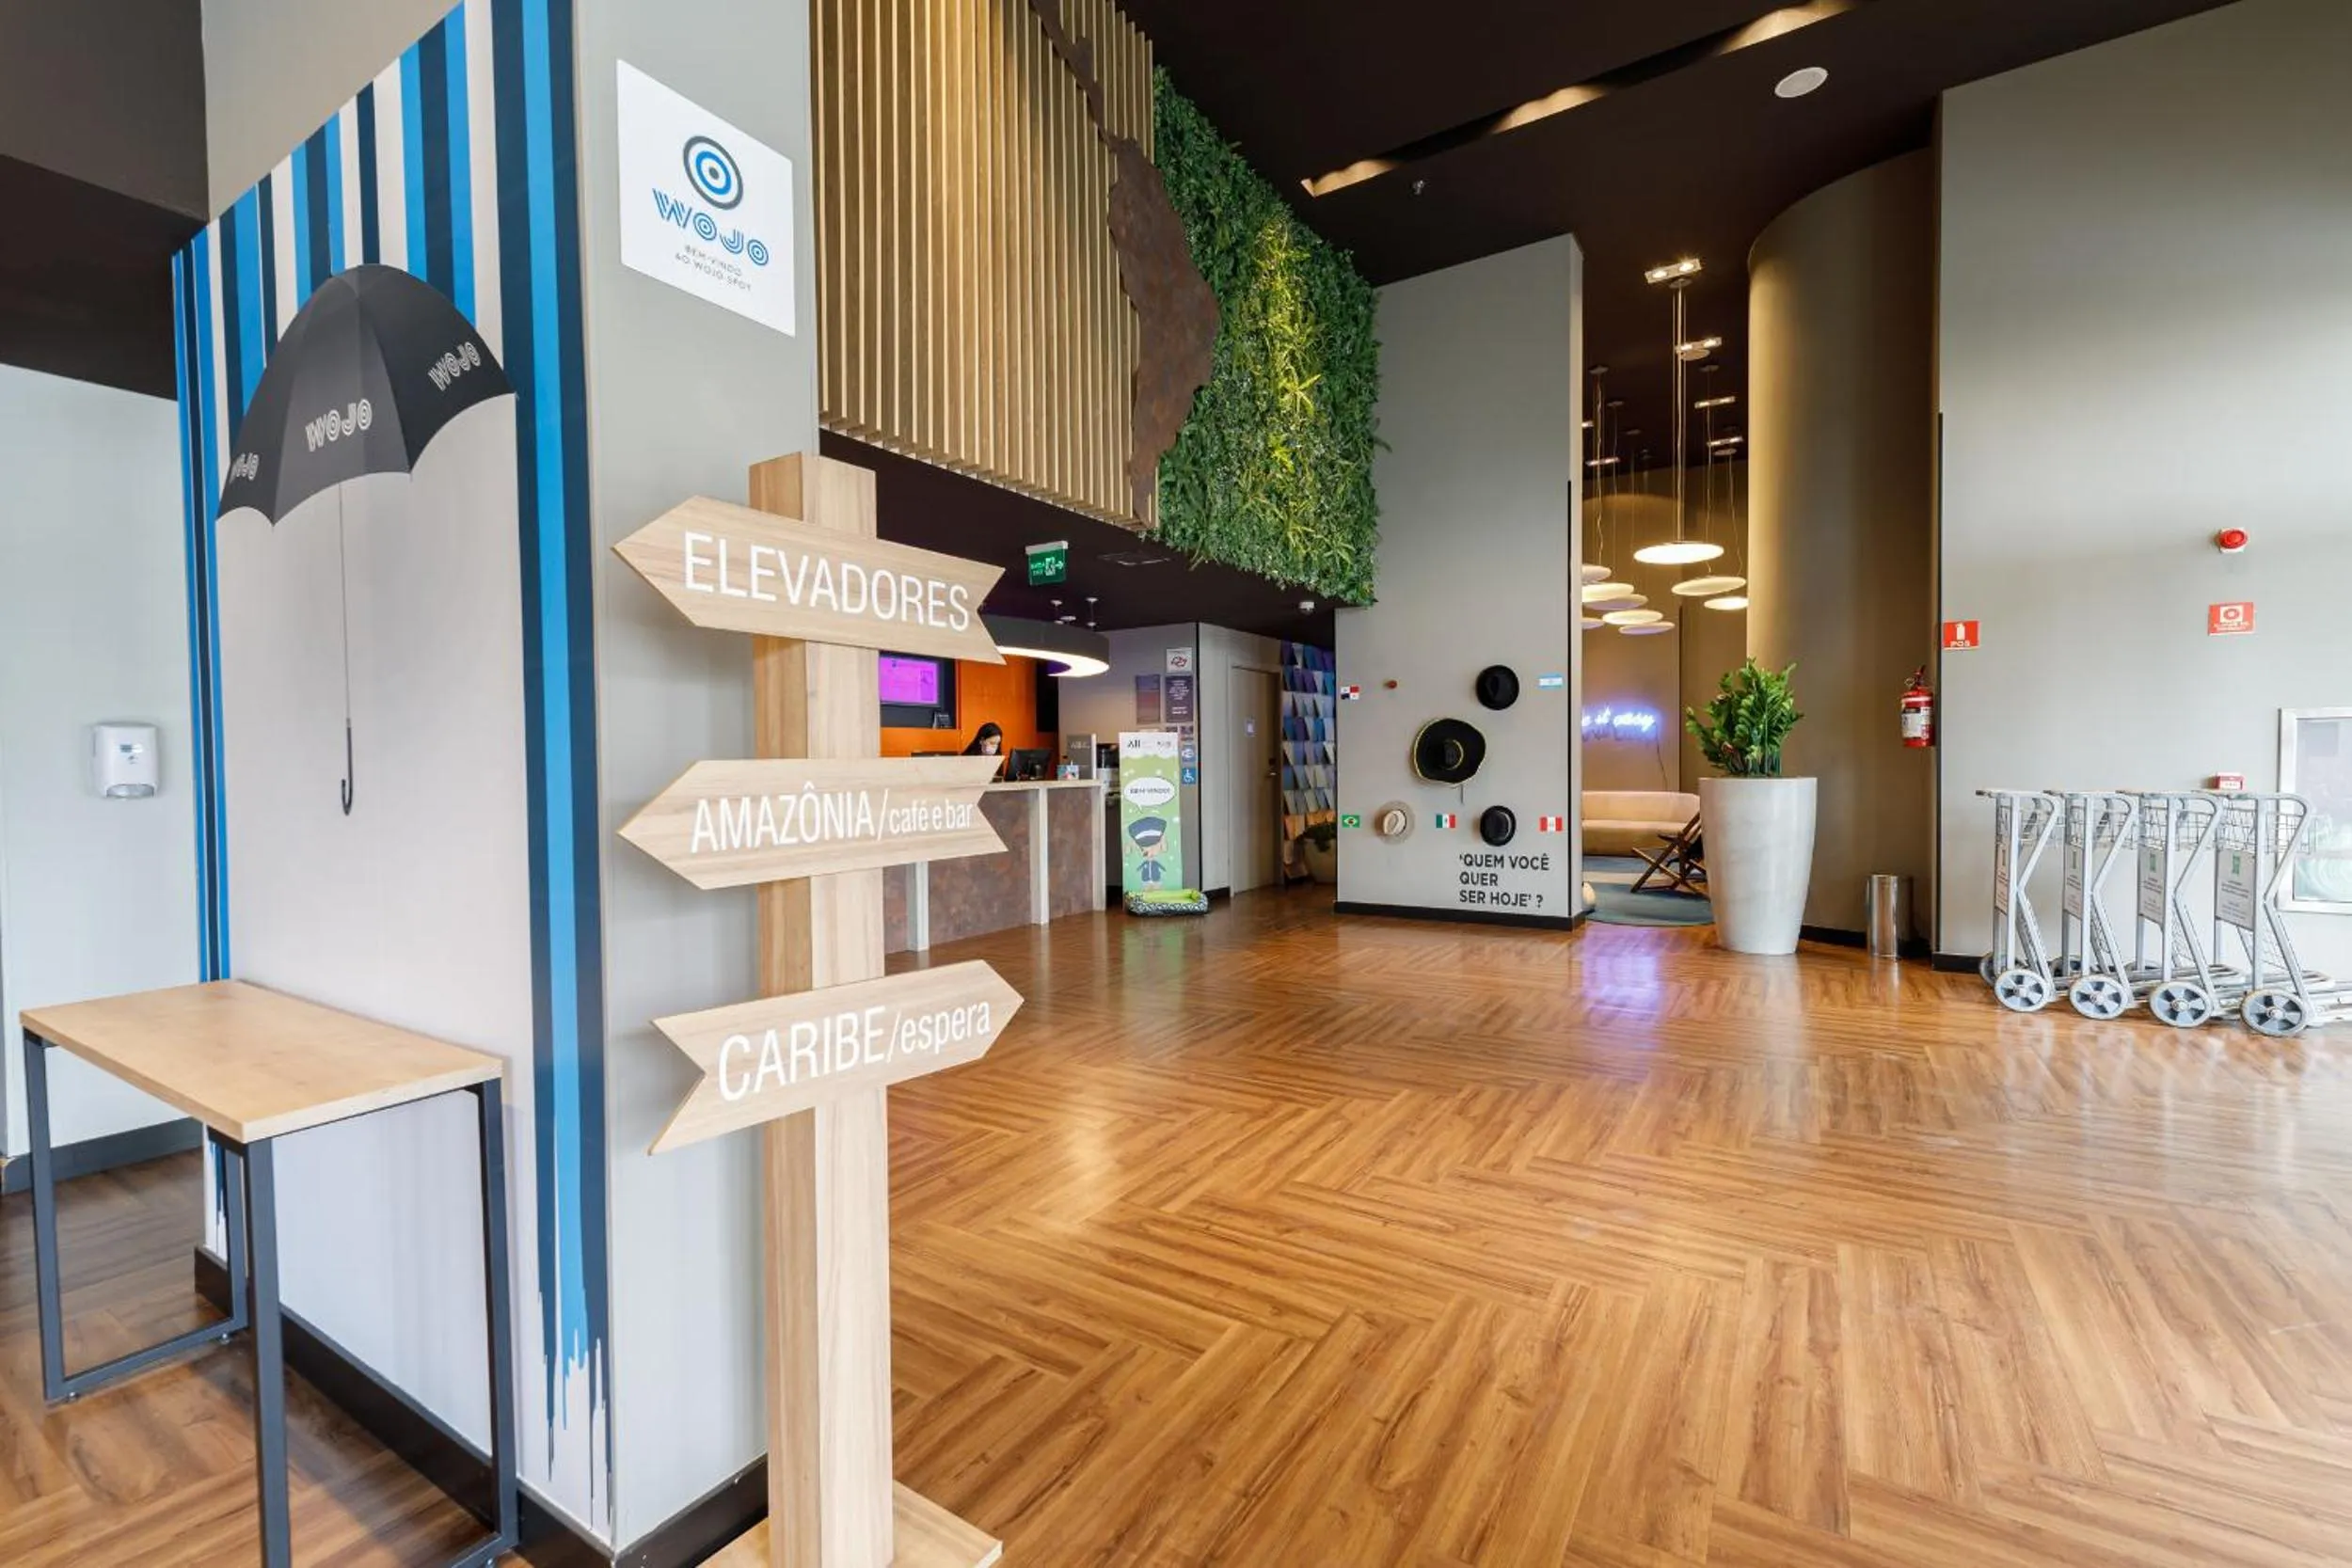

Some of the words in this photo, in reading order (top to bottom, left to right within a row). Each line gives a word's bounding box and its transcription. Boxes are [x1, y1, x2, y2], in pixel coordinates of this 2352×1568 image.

[652, 187, 770, 266] WOJO
[428, 341, 481, 392] WOJO
[305, 398, 373, 452] WOJO
[684, 531, 970, 632] ELEVADORES
[931, 804, 943, 829] e
[946, 799, 975, 830] bar
[1459, 871, 1499, 886] QUER
[1508, 852, 1550, 871] VOCÊ
[1459, 890, 1486, 904] SER
